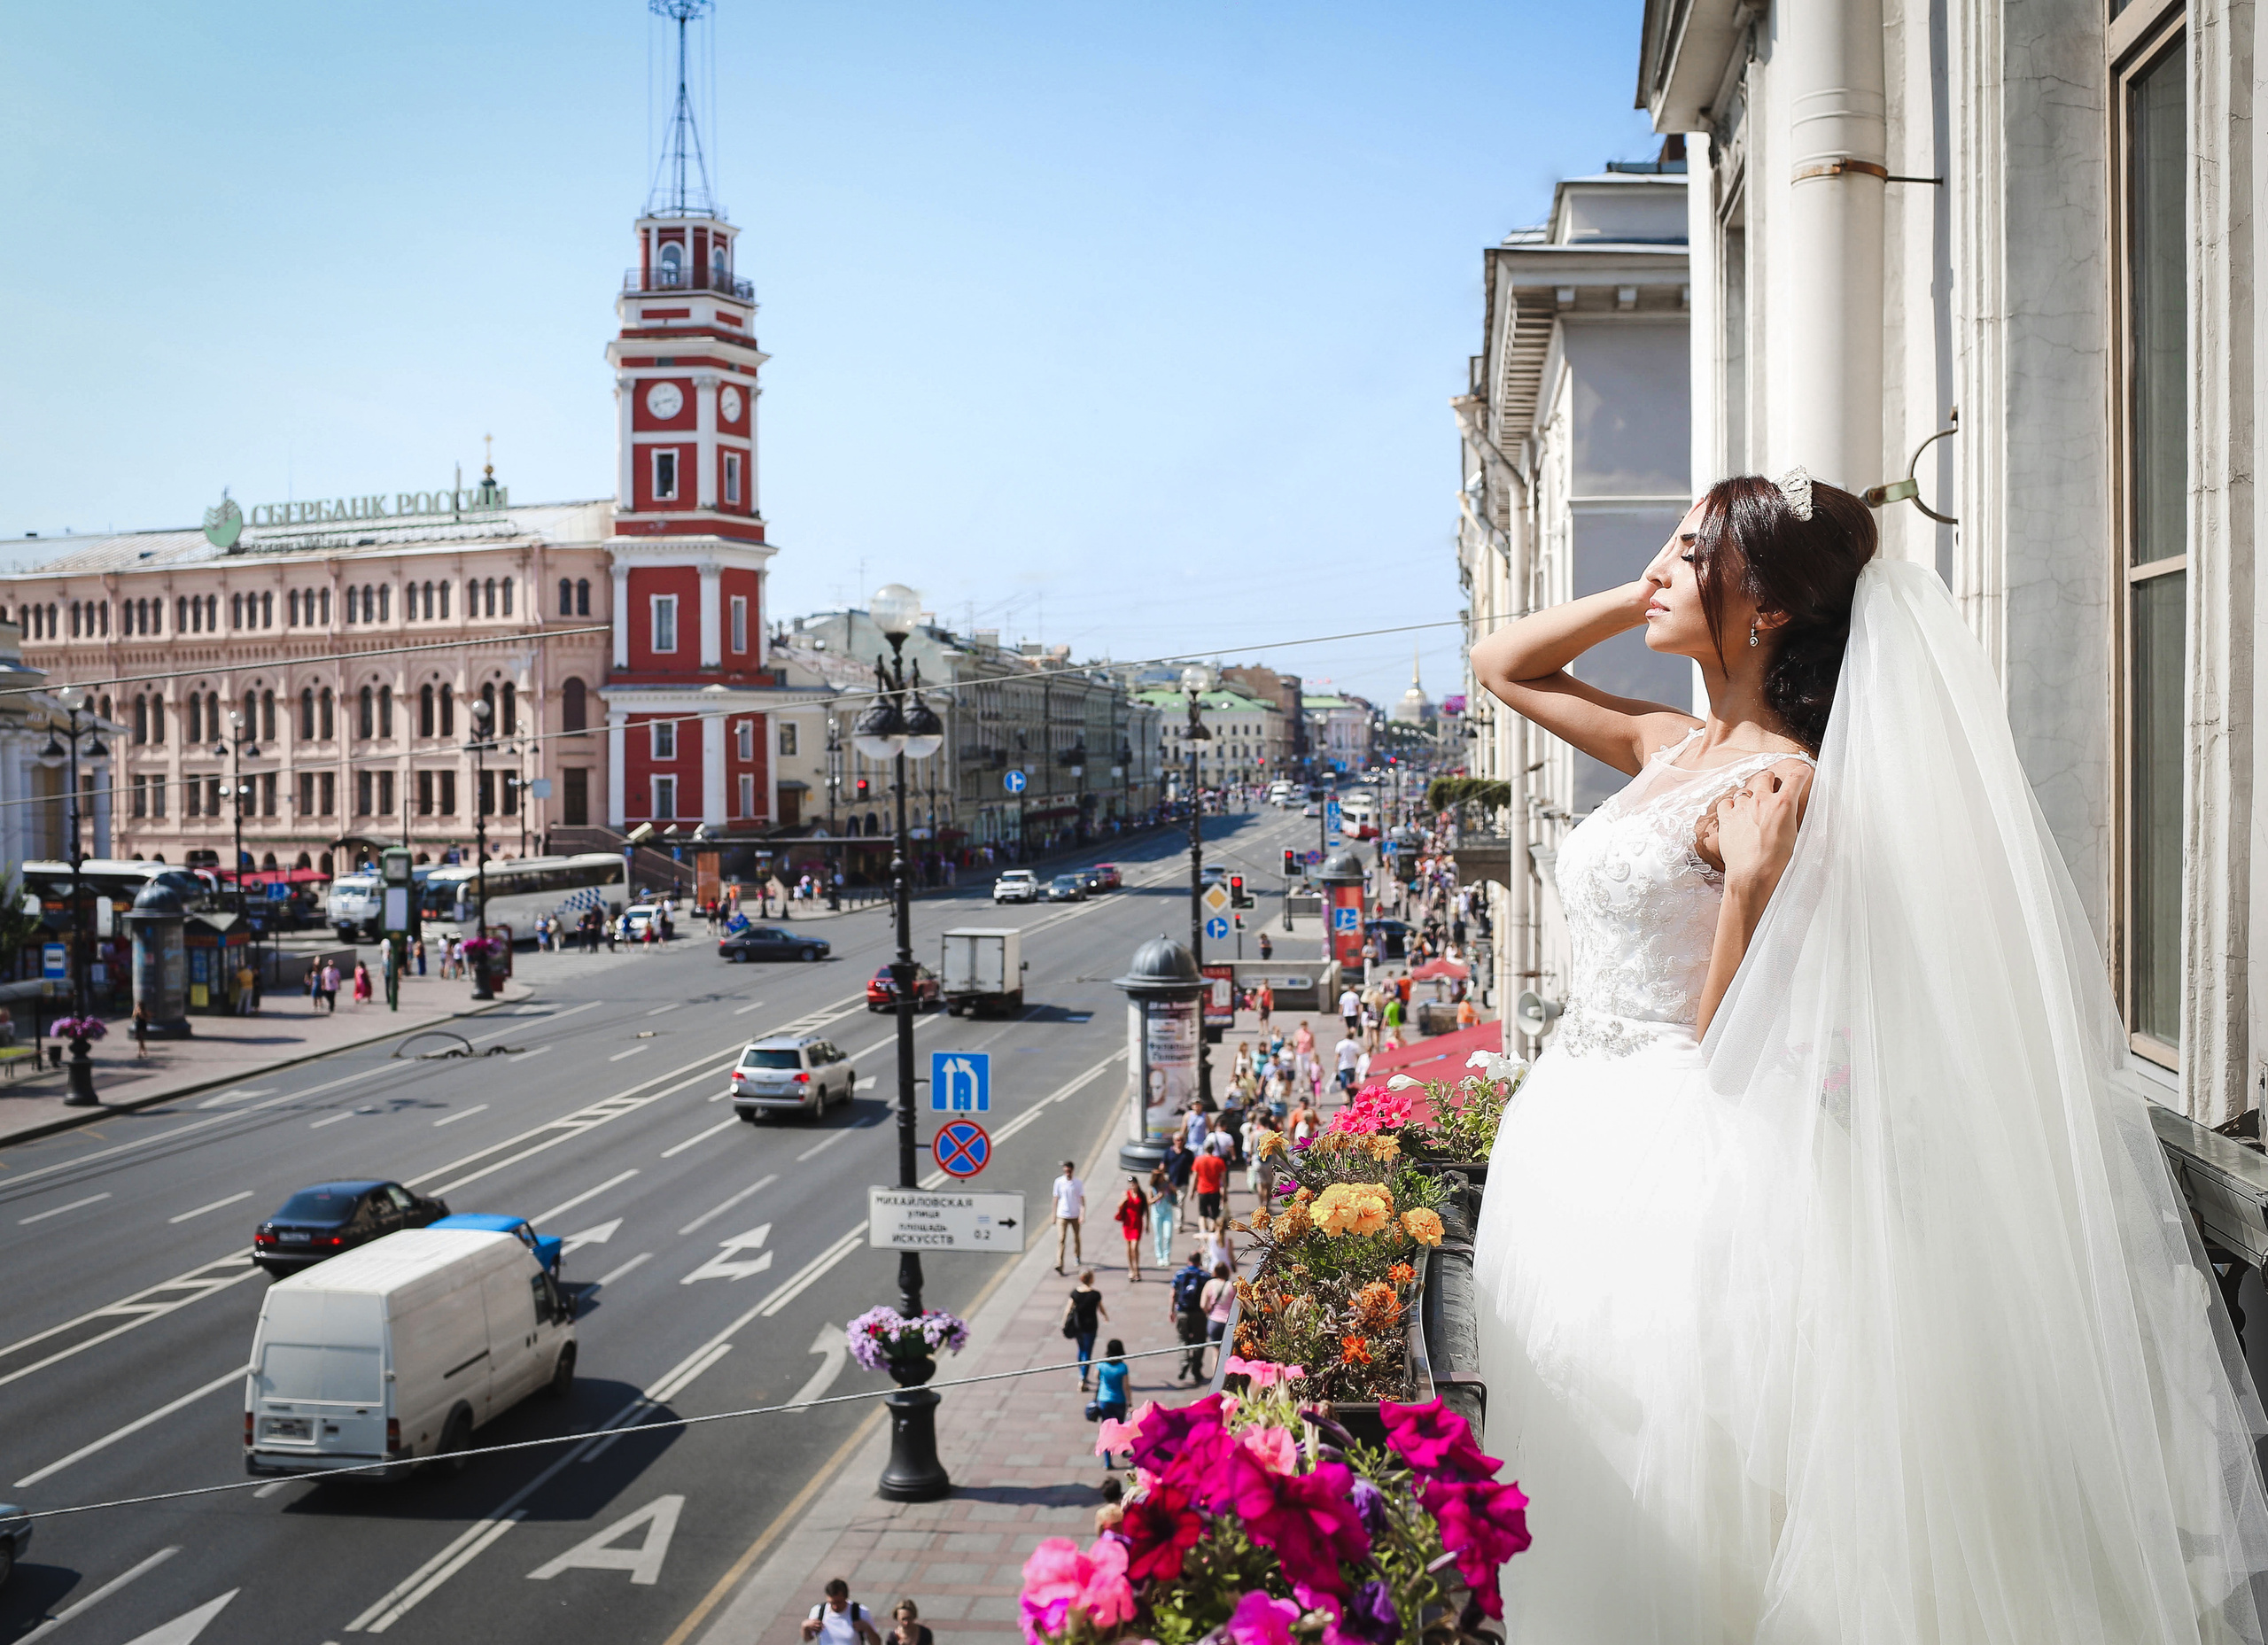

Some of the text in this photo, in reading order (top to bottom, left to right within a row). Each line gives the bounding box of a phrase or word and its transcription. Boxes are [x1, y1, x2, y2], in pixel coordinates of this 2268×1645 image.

[252, 486, 508, 527] СБЕРБАНК РОССИИ
[875, 1196, 973, 1207] МИХАЙЛОВСКАЯ
[892, 1235, 954, 1245] ИСКУССТВ
